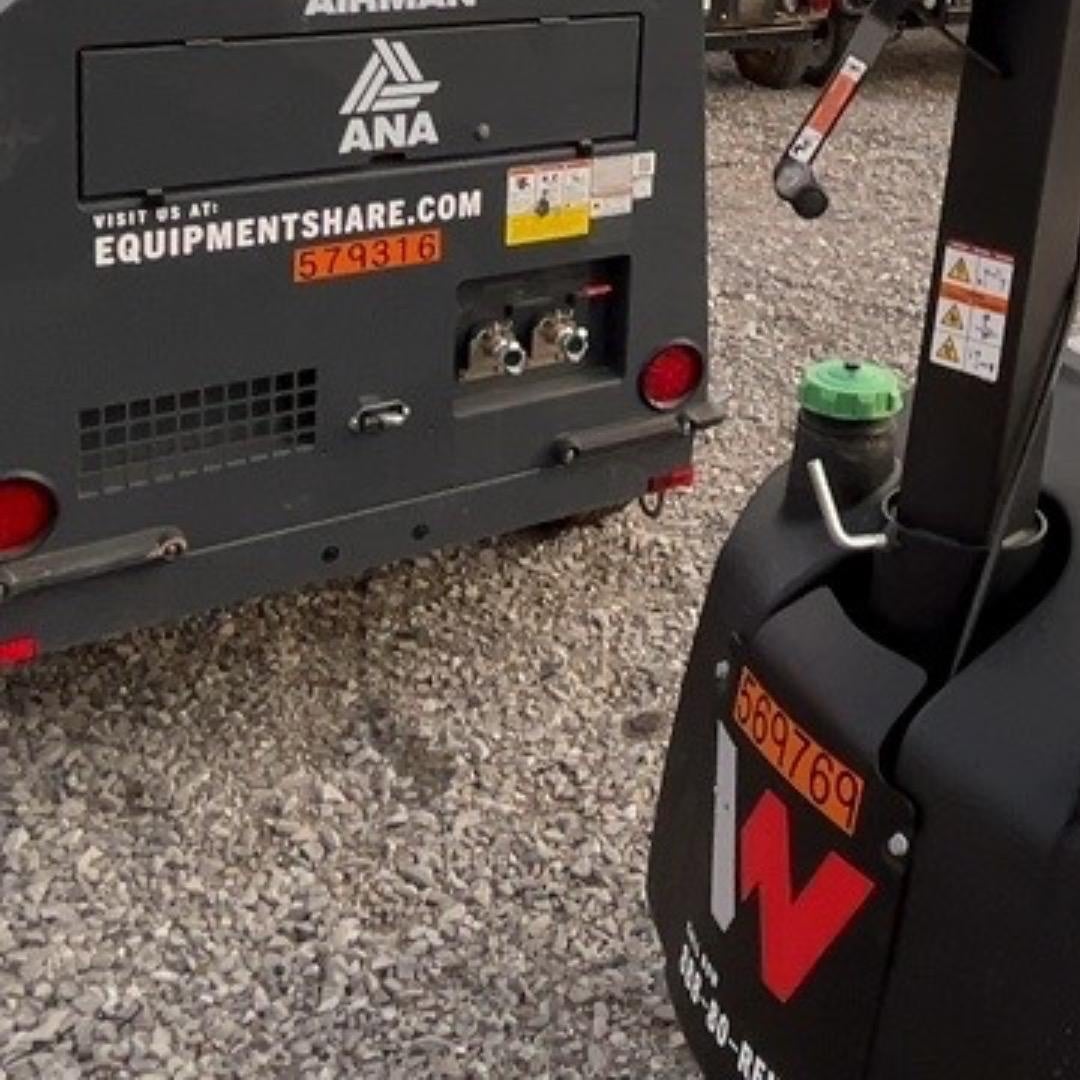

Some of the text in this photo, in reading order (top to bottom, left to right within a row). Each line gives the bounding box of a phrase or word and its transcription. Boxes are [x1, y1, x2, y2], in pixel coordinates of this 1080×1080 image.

[338, 111, 439, 153] ANA
[93, 200, 219, 228] VISIT US AT:
[94, 190, 483, 268] EQUIPMENTSHARE.COM
[298, 232, 437, 279] 579316
[737, 678, 858, 829] 569769
